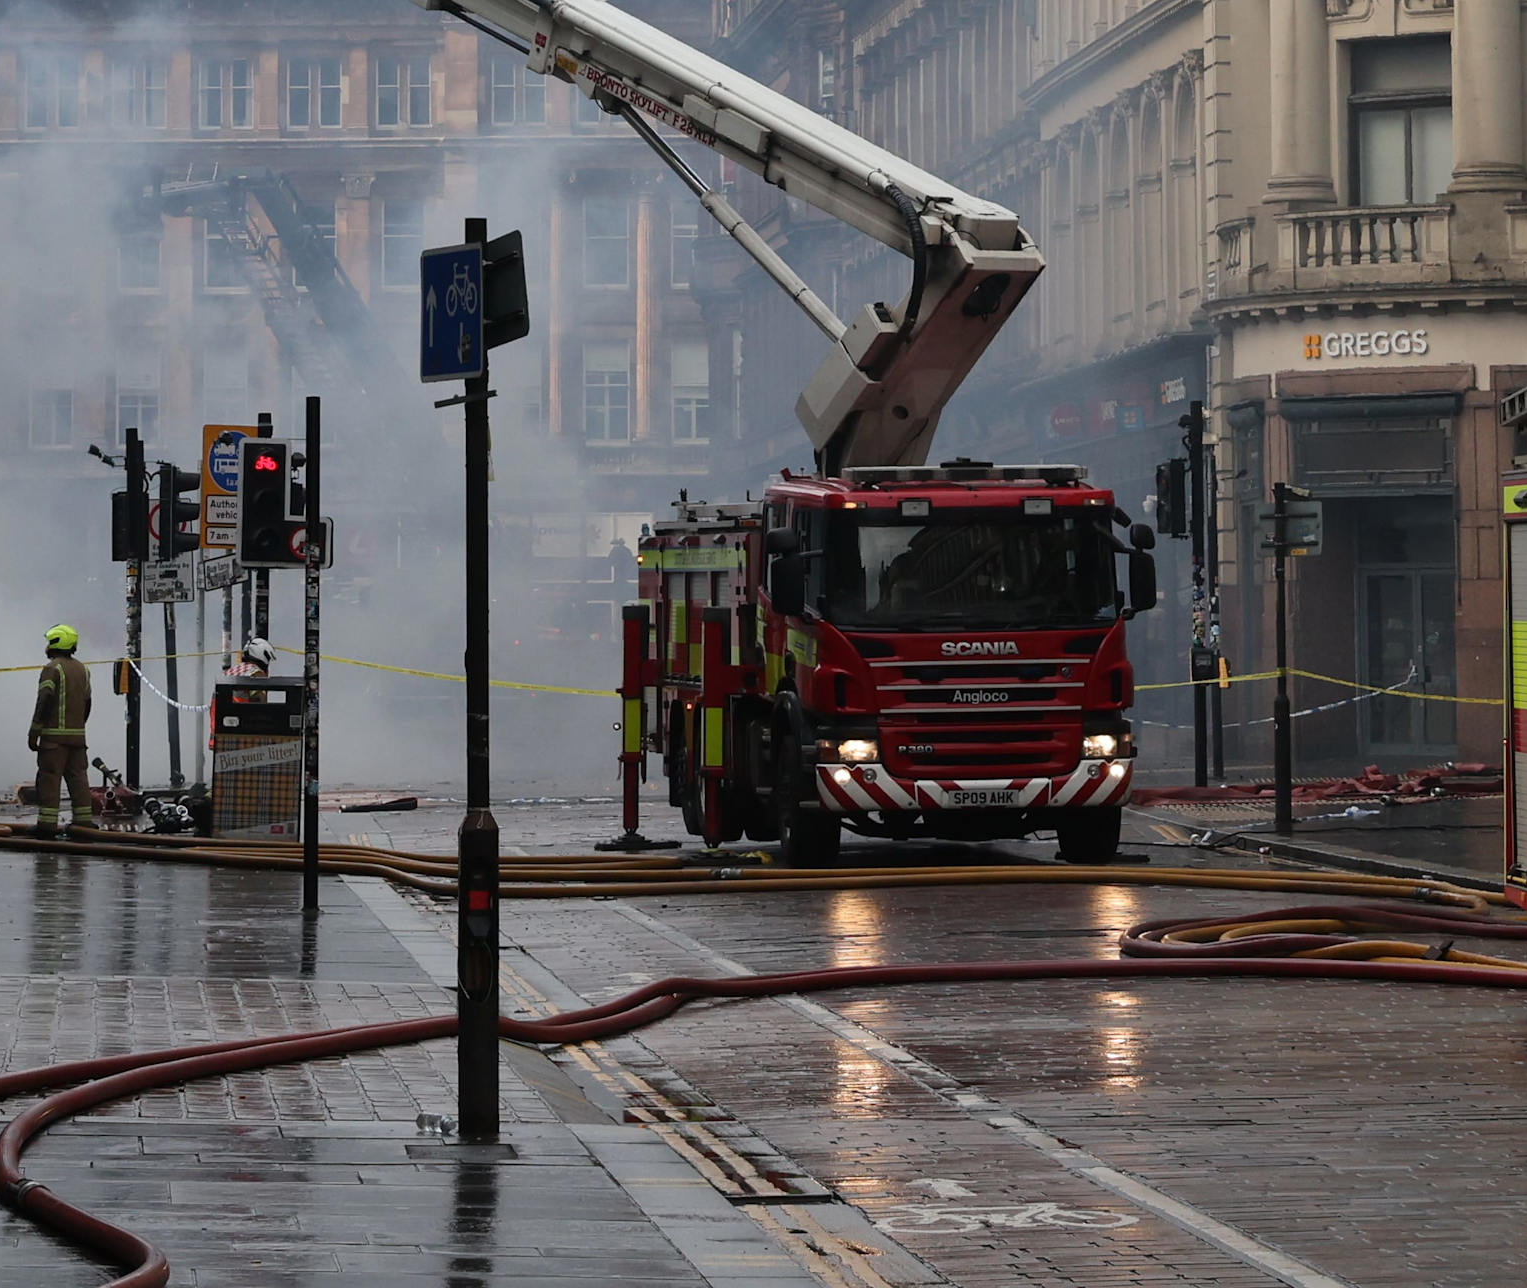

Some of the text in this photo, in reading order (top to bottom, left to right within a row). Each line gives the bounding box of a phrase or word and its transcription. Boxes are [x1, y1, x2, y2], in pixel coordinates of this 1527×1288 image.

[1324, 329, 1428, 357] GREGGS
[941, 641, 1019, 655] SCANIA
[953, 690, 1008, 704] Angloco
[219, 743, 298, 769] Bin your litter!
[954, 791, 1013, 805] SP09 AHK
